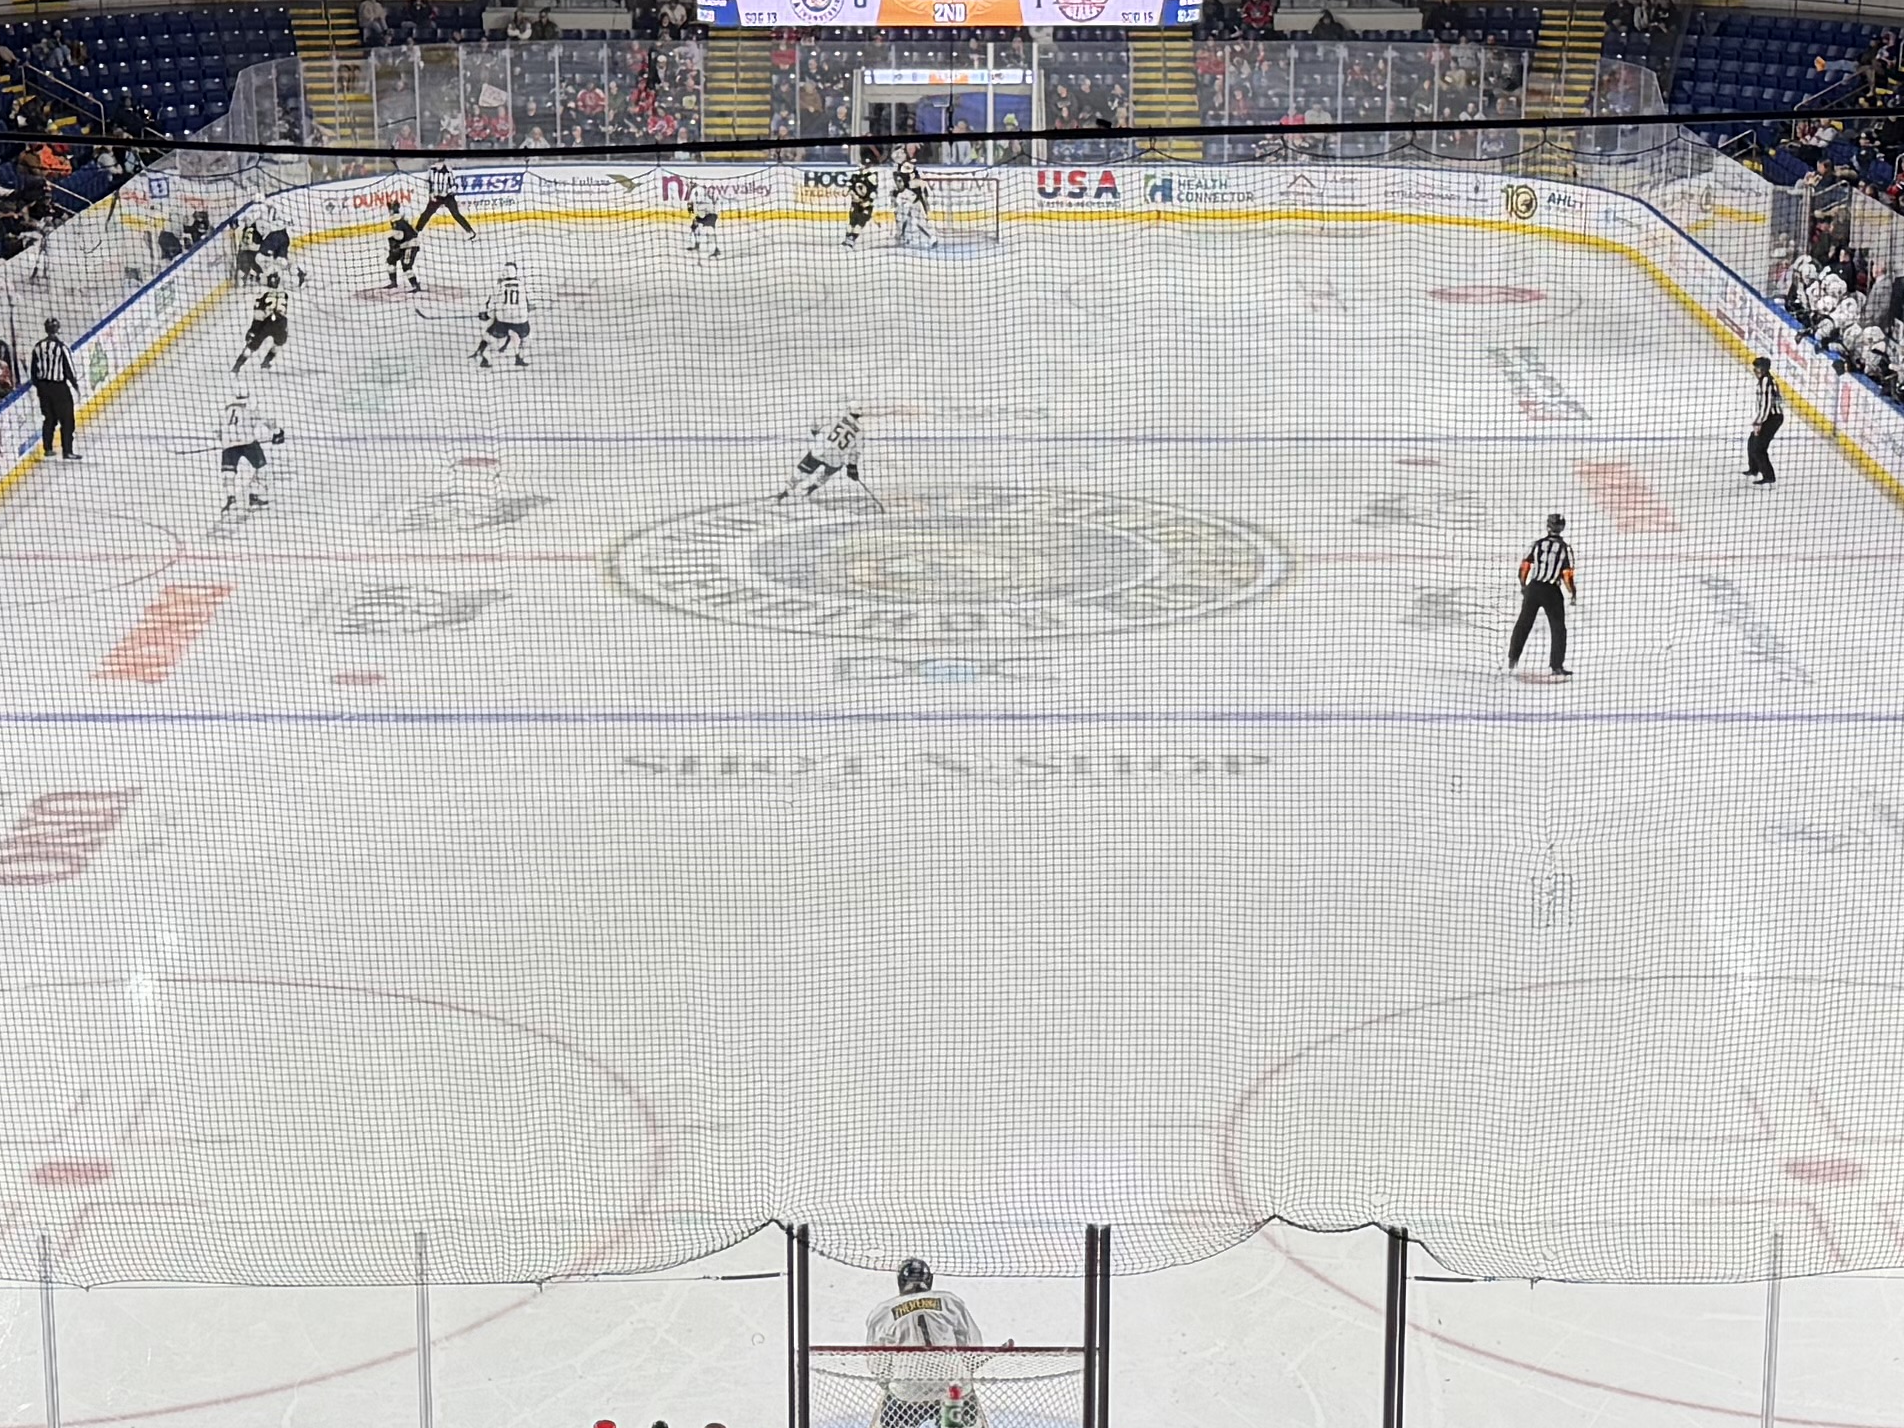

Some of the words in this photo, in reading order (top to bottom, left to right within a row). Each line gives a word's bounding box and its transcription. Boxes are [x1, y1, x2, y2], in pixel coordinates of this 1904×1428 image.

[933, 4, 967, 23] 2ND
[454, 174, 521, 192] ALISE
[804, 171, 848, 188] HOG
[1036, 170, 1121, 199] USA
[1177, 178, 1228, 191] HEALTH
[732, 180, 772, 198] valley
[1177, 191, 1255, 204] CONNECTOR
[352, 189, 415, 210] DUNKIN'
[503, 289, 519, 305] 10
[828, 423, 856, 451] 55
[918, 1314, 932, 1347] 1
